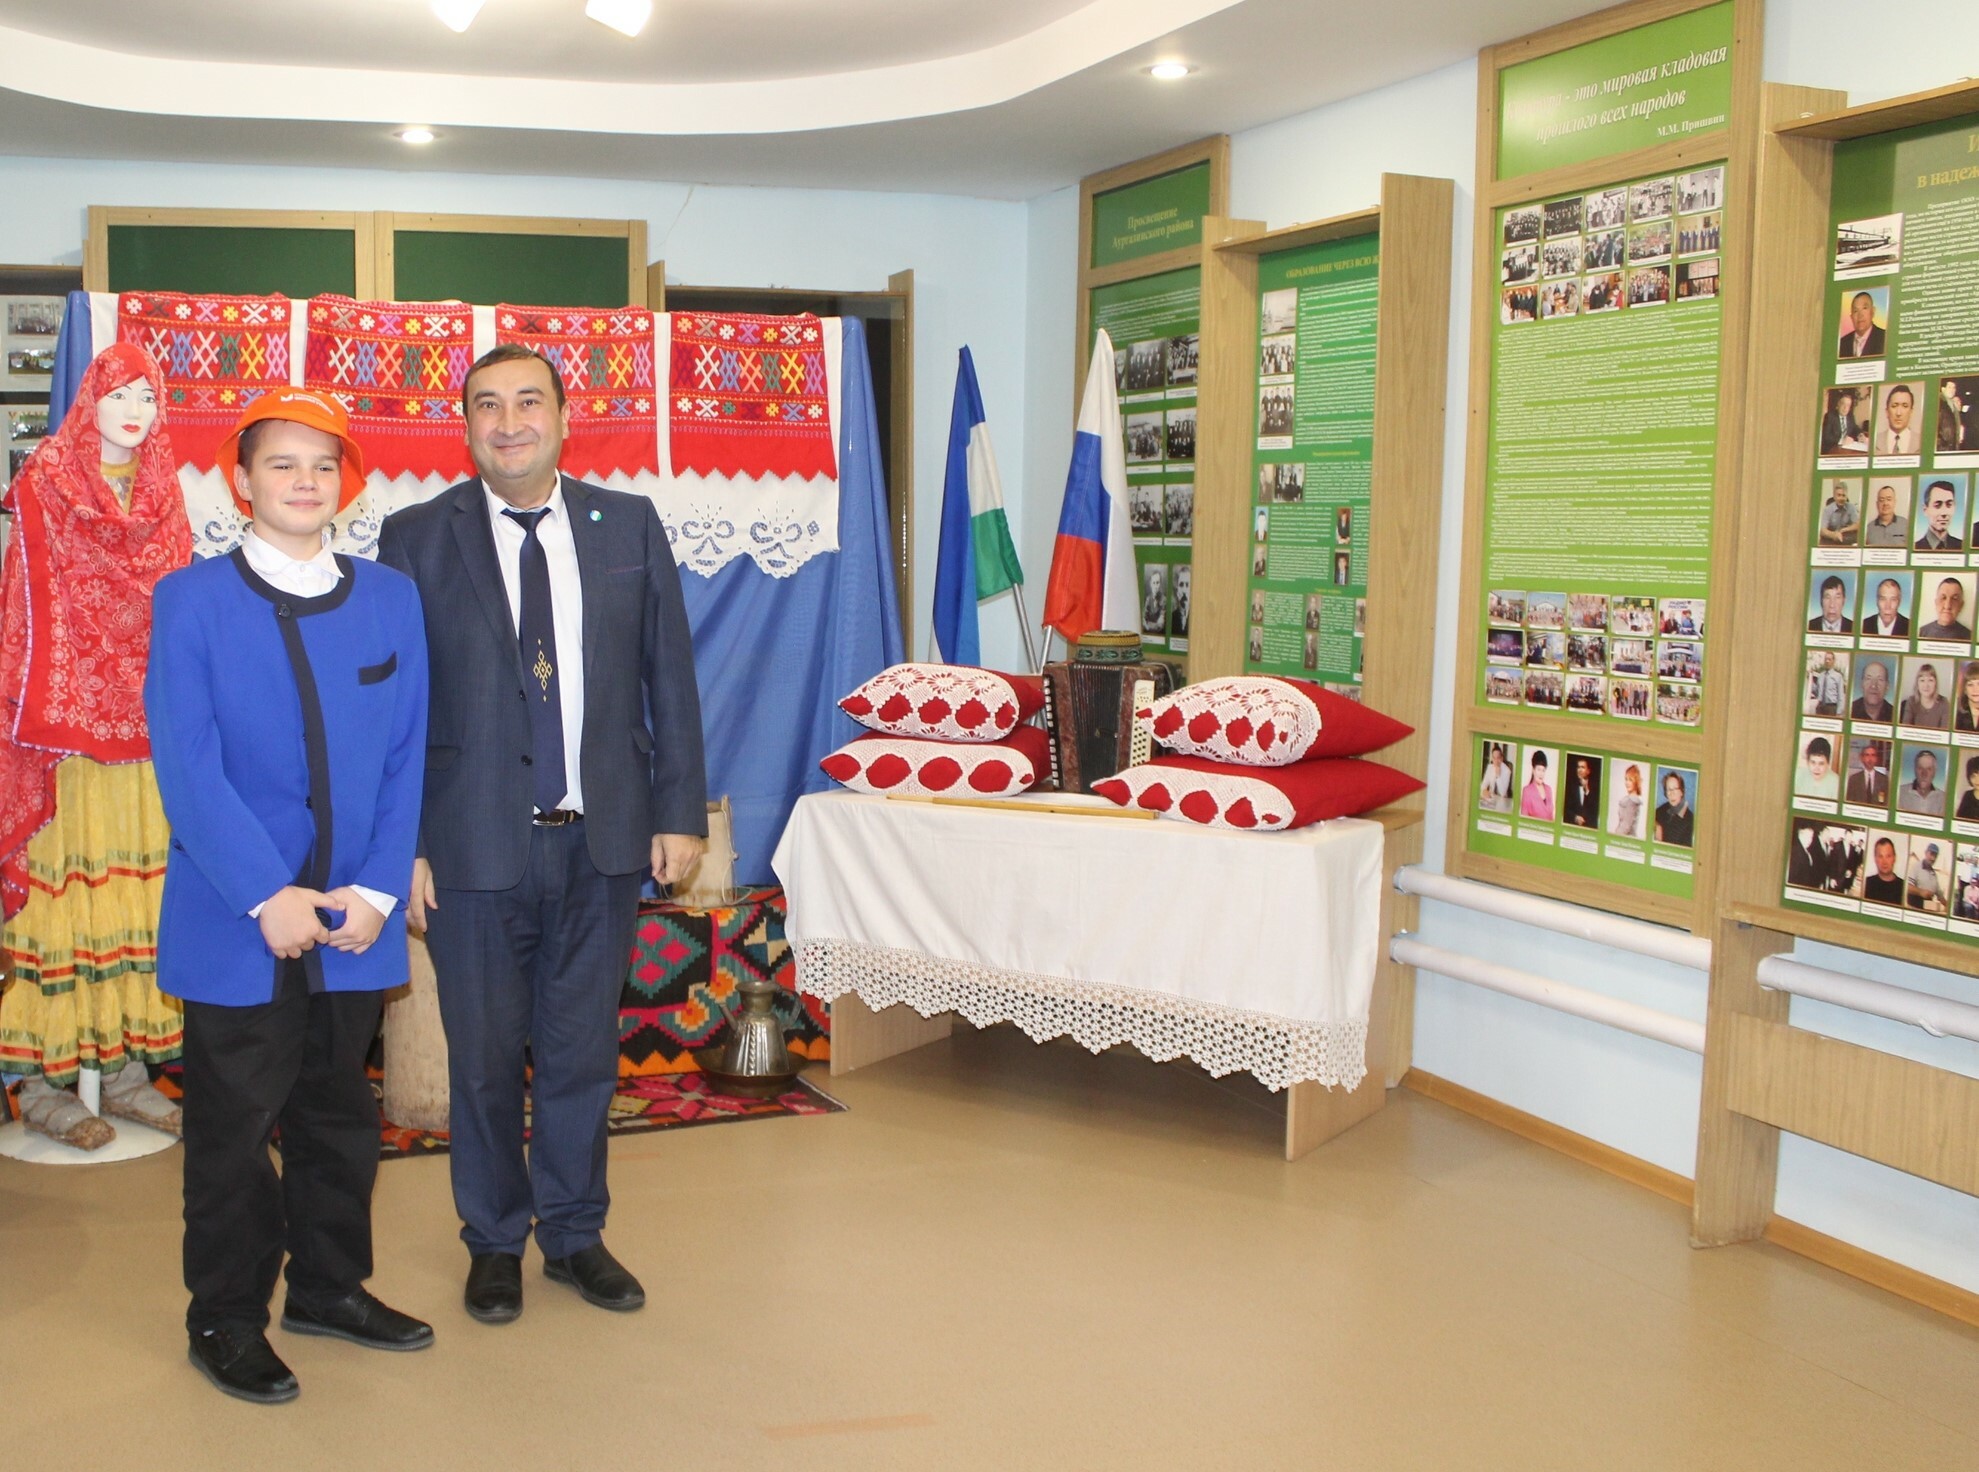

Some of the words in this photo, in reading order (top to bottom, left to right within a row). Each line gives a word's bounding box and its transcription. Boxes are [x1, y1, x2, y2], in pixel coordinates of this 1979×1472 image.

[1574, 83, 1598, 102] это
[1600, 66, 1658, 97] мировая
[1661, 45, 1727, 78] кладовая
[1537, 112, 1597, 145] прошлого
[1600, 104, 1628, 125] всех
[1630, 88, 1686, 120] народов
[1657, 123, 1680, 138] М.М.
[1681, 114, 1725, 133] Пришвин
[1127, 207, 1178, 232] Просвещение
[1166, 219, 1194, 239] района
[1285, 262, 1332, 279] ОБРАЗОВАНИЕ
[1333, 258, 1354, 271] ЧЕРЕЗ
[1355, 256, 1372, 267] ВСЮ
